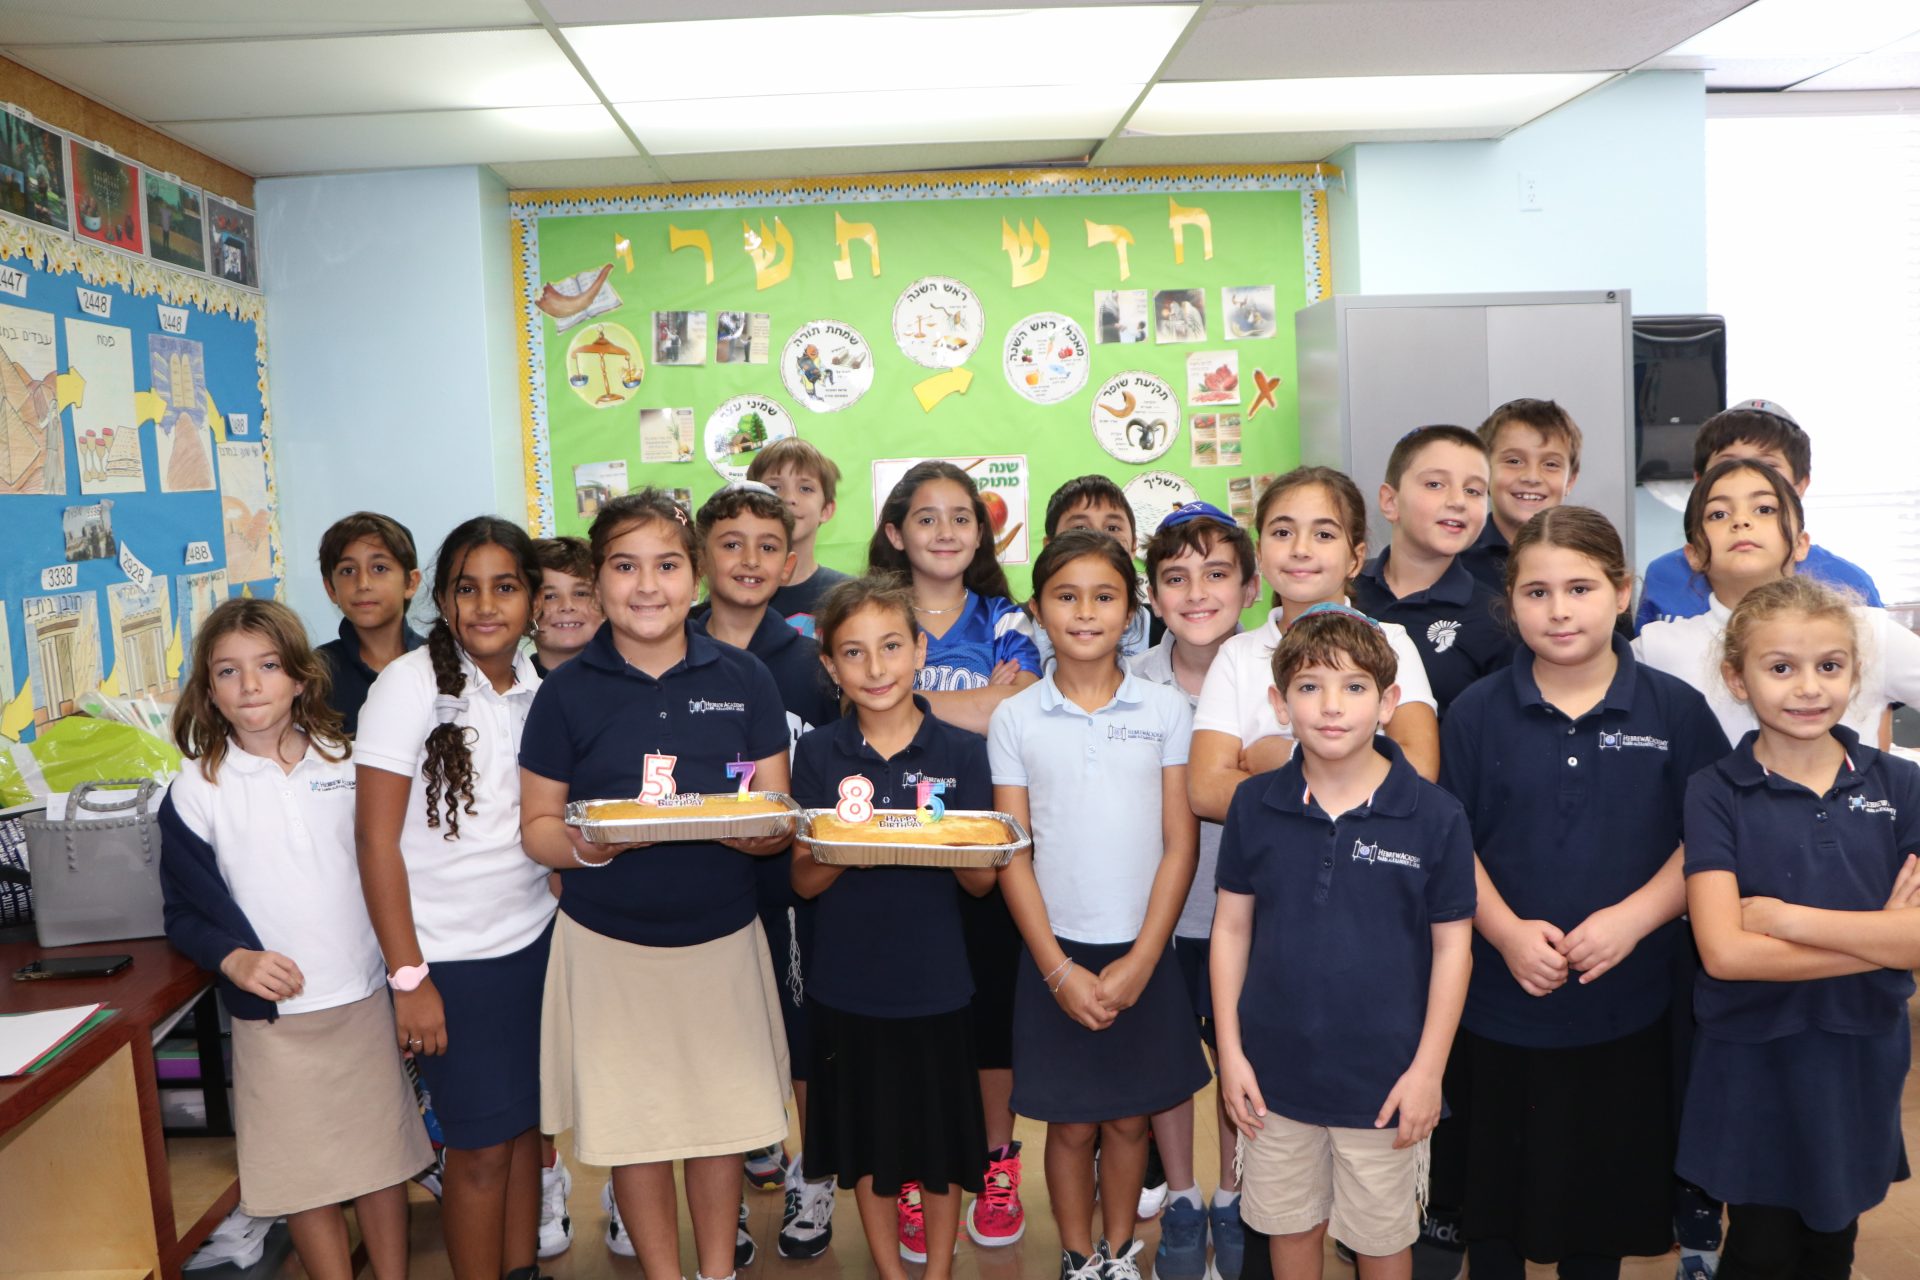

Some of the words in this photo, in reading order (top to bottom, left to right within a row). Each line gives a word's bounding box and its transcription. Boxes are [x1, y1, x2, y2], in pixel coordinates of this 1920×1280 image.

[615, 211, 881, 291] תשרי
[1002, 195, 1213, 288] חדש
[0, 269, 23, 291] 447
[907, 283, 937, 302] השנה
[943, 283, 967, 301] ראש
[83, 292, 107, 313] 2448
[825, 325, 859, 345] שמחת
[1030, 321, 1056, 331] ראש
[793, 327, 820, 347] תורה
[1010, 331, 1027, 361] השנה
[1103, 379, 1128, 397] שופר
[1134, 378, 1169, 400] תקיעת
[747, 401, 777, 416] שמיני
[989, 462, 1019, 473] שנה
[974, 476, 1019, 490] מתוק
[1144, 475, 1181, 492] תשליך
[186, 545, 209, 562] 488
[48, 566, 73, 588] 3338
[637, 754, 677, 805] 5
[726, 761, 756, 802] 7
[836, 775, 875, 824] 8
[916, 783, 946, 824] 5
[880, 820, 922, 828] BIRTHDAY
